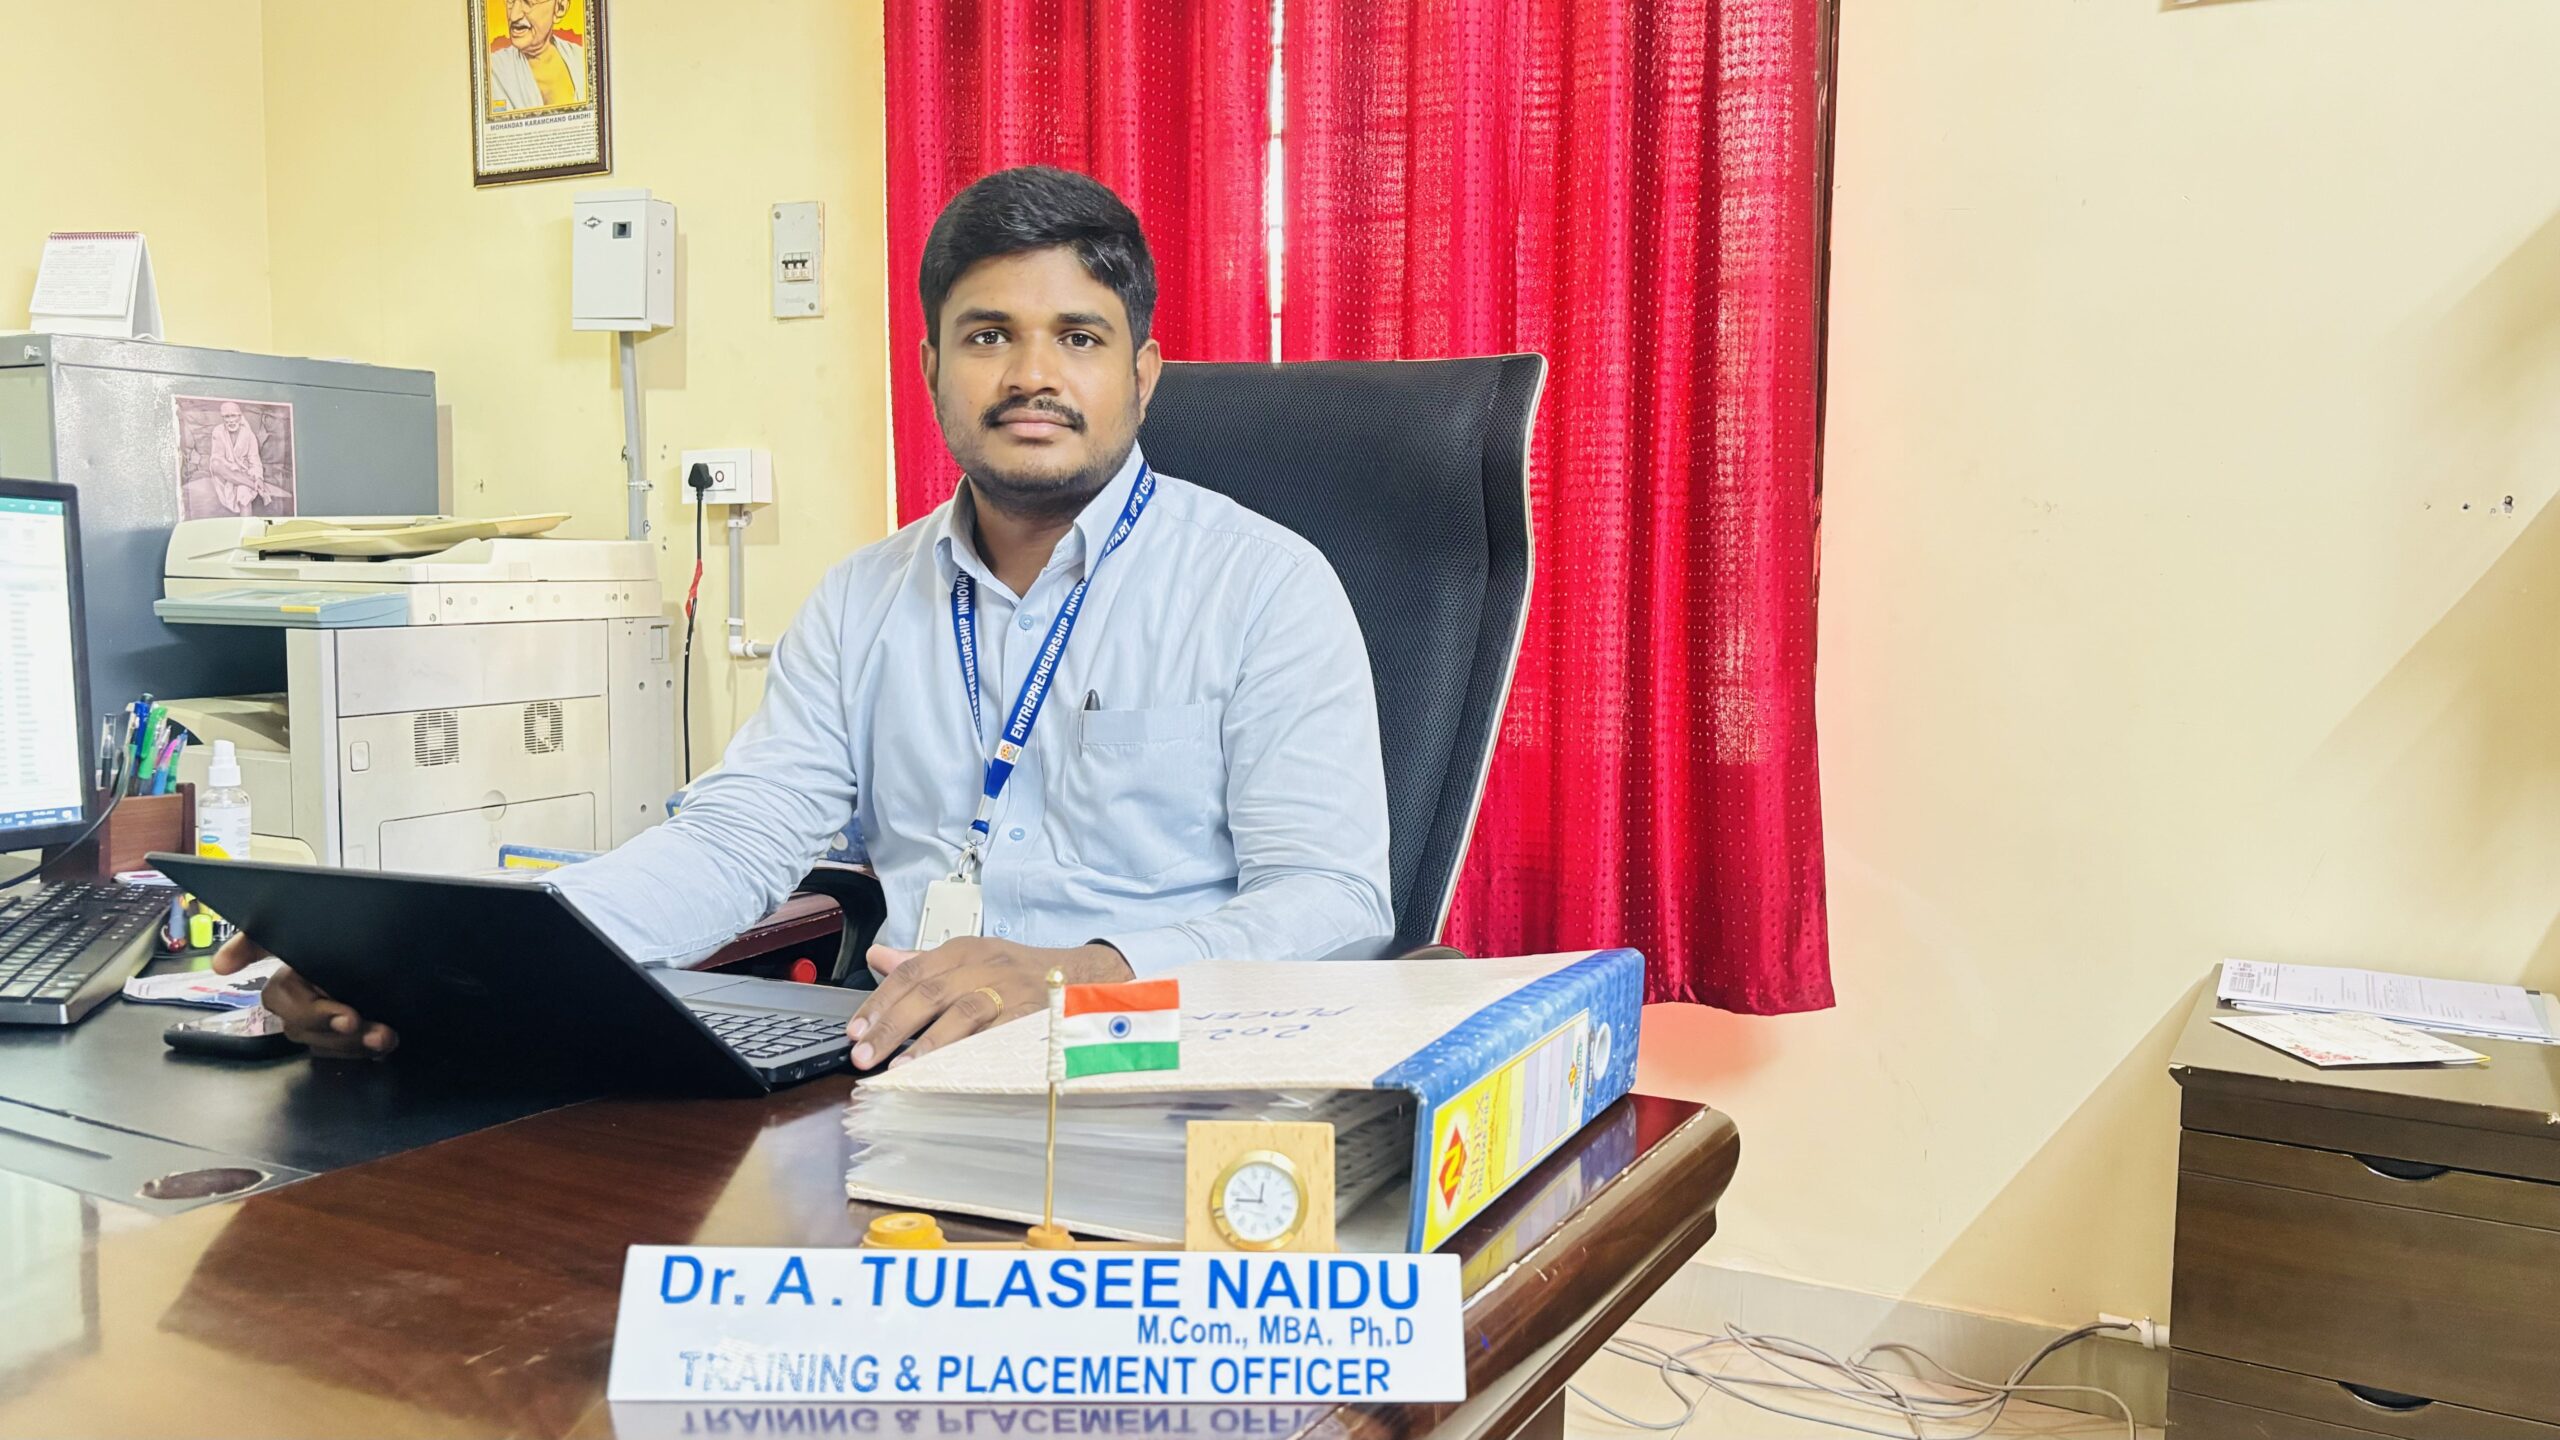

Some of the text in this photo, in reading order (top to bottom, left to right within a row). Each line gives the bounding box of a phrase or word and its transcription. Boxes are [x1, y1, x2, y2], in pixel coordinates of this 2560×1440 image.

[490, 112, 591, 131] MOHANDAS KARAMCHAND GANDHI
[1010, 617, 1070, 740] ENTREPRENEURSHIP
[659, 1254, 746, 1306] Dr.
[861, 1256, 1180, 1309] TULASEE
[1207, 1258, 1420, 1310] NAIDU
[1137, 1314, 1248, 1349] M.Com.,
[1350, 1316, 1414, 1347] Ph.D
[679, 1350, 1391, 1396] TRAINING & PLACEMENT OFFICER
